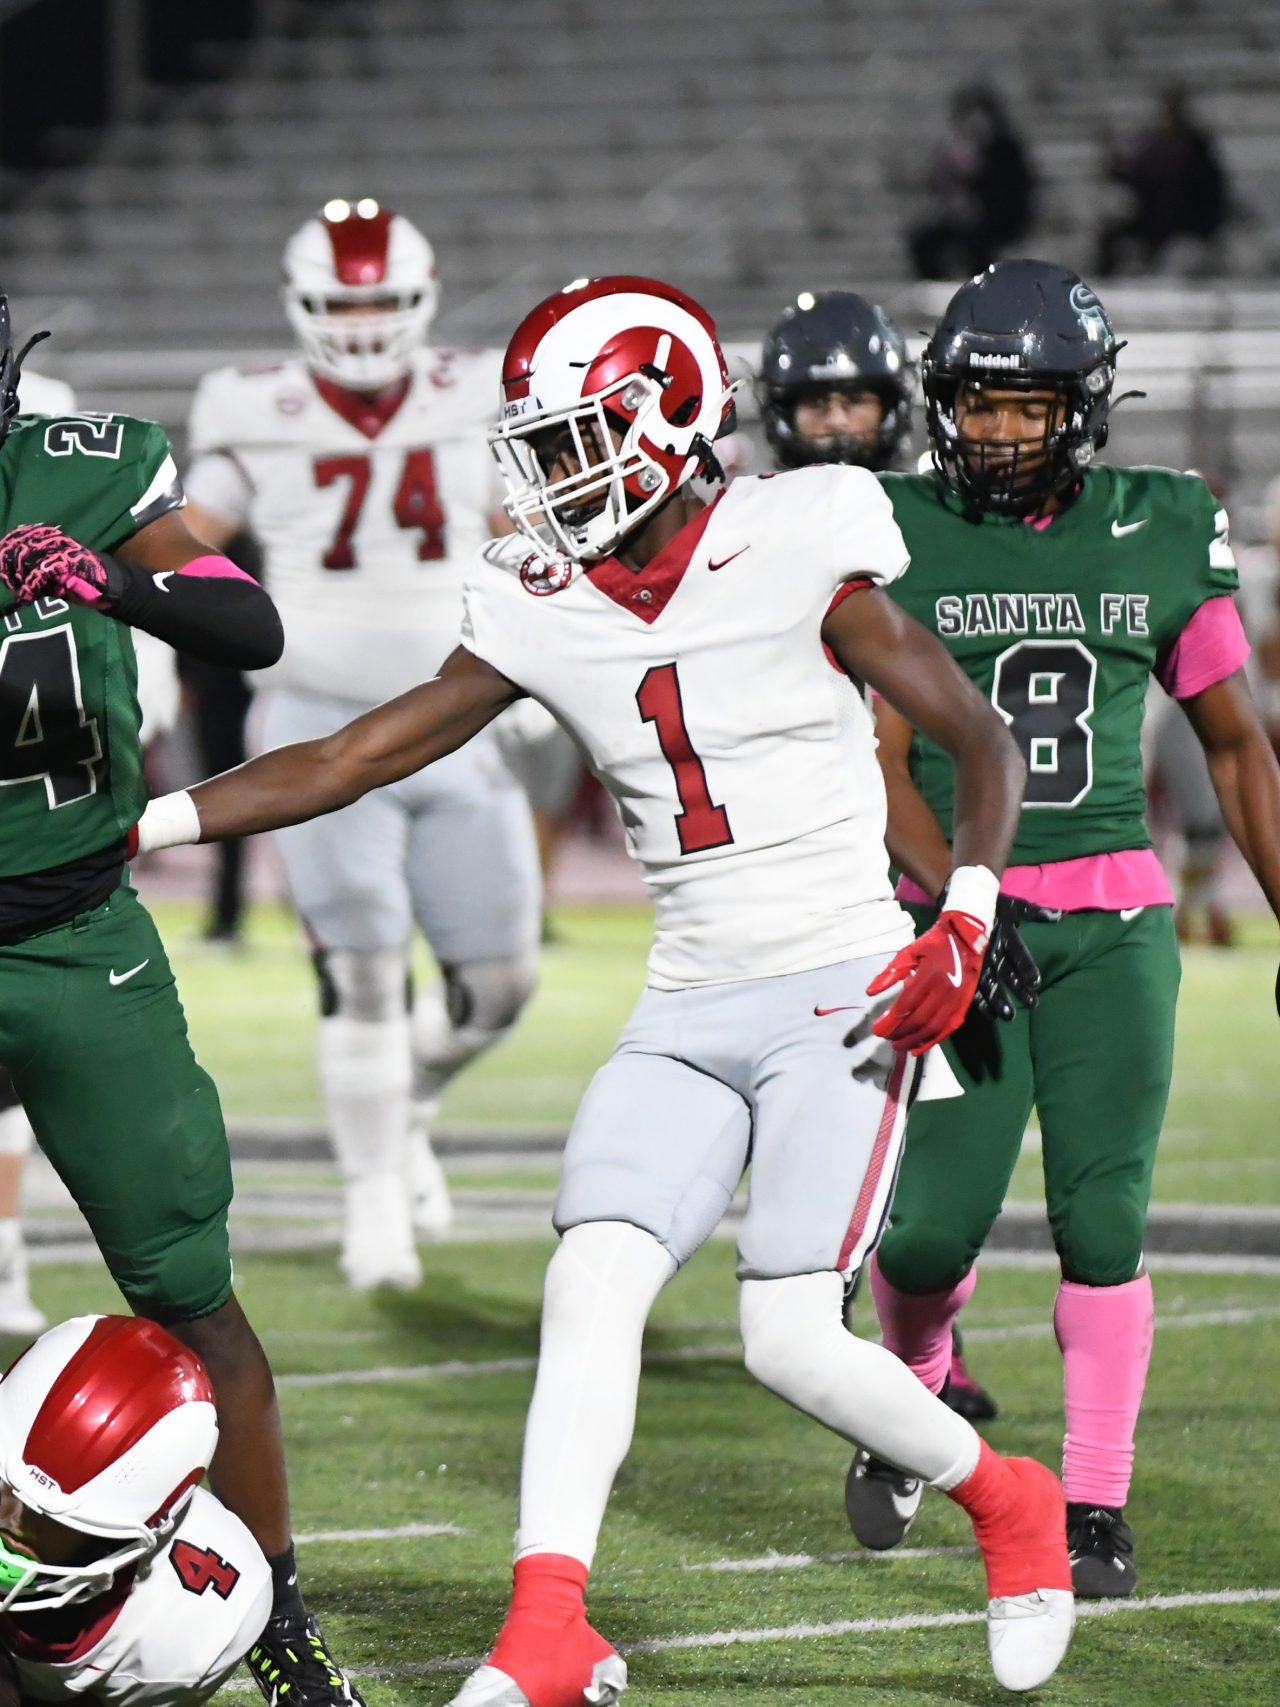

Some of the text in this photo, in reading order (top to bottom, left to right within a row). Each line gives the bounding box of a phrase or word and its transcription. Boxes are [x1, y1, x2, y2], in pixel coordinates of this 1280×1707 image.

[970, 352, 1020, 369] Riddell
[313, 445, 447, 570] 74
[935, 593, 1150, 638] SANTA FE
[991, 638, 1098, 809] 8
[634, 661, 735, 856] 1
[29, 1467, 57, 1491] HST
[168, 1538, 241, 1601] 4
